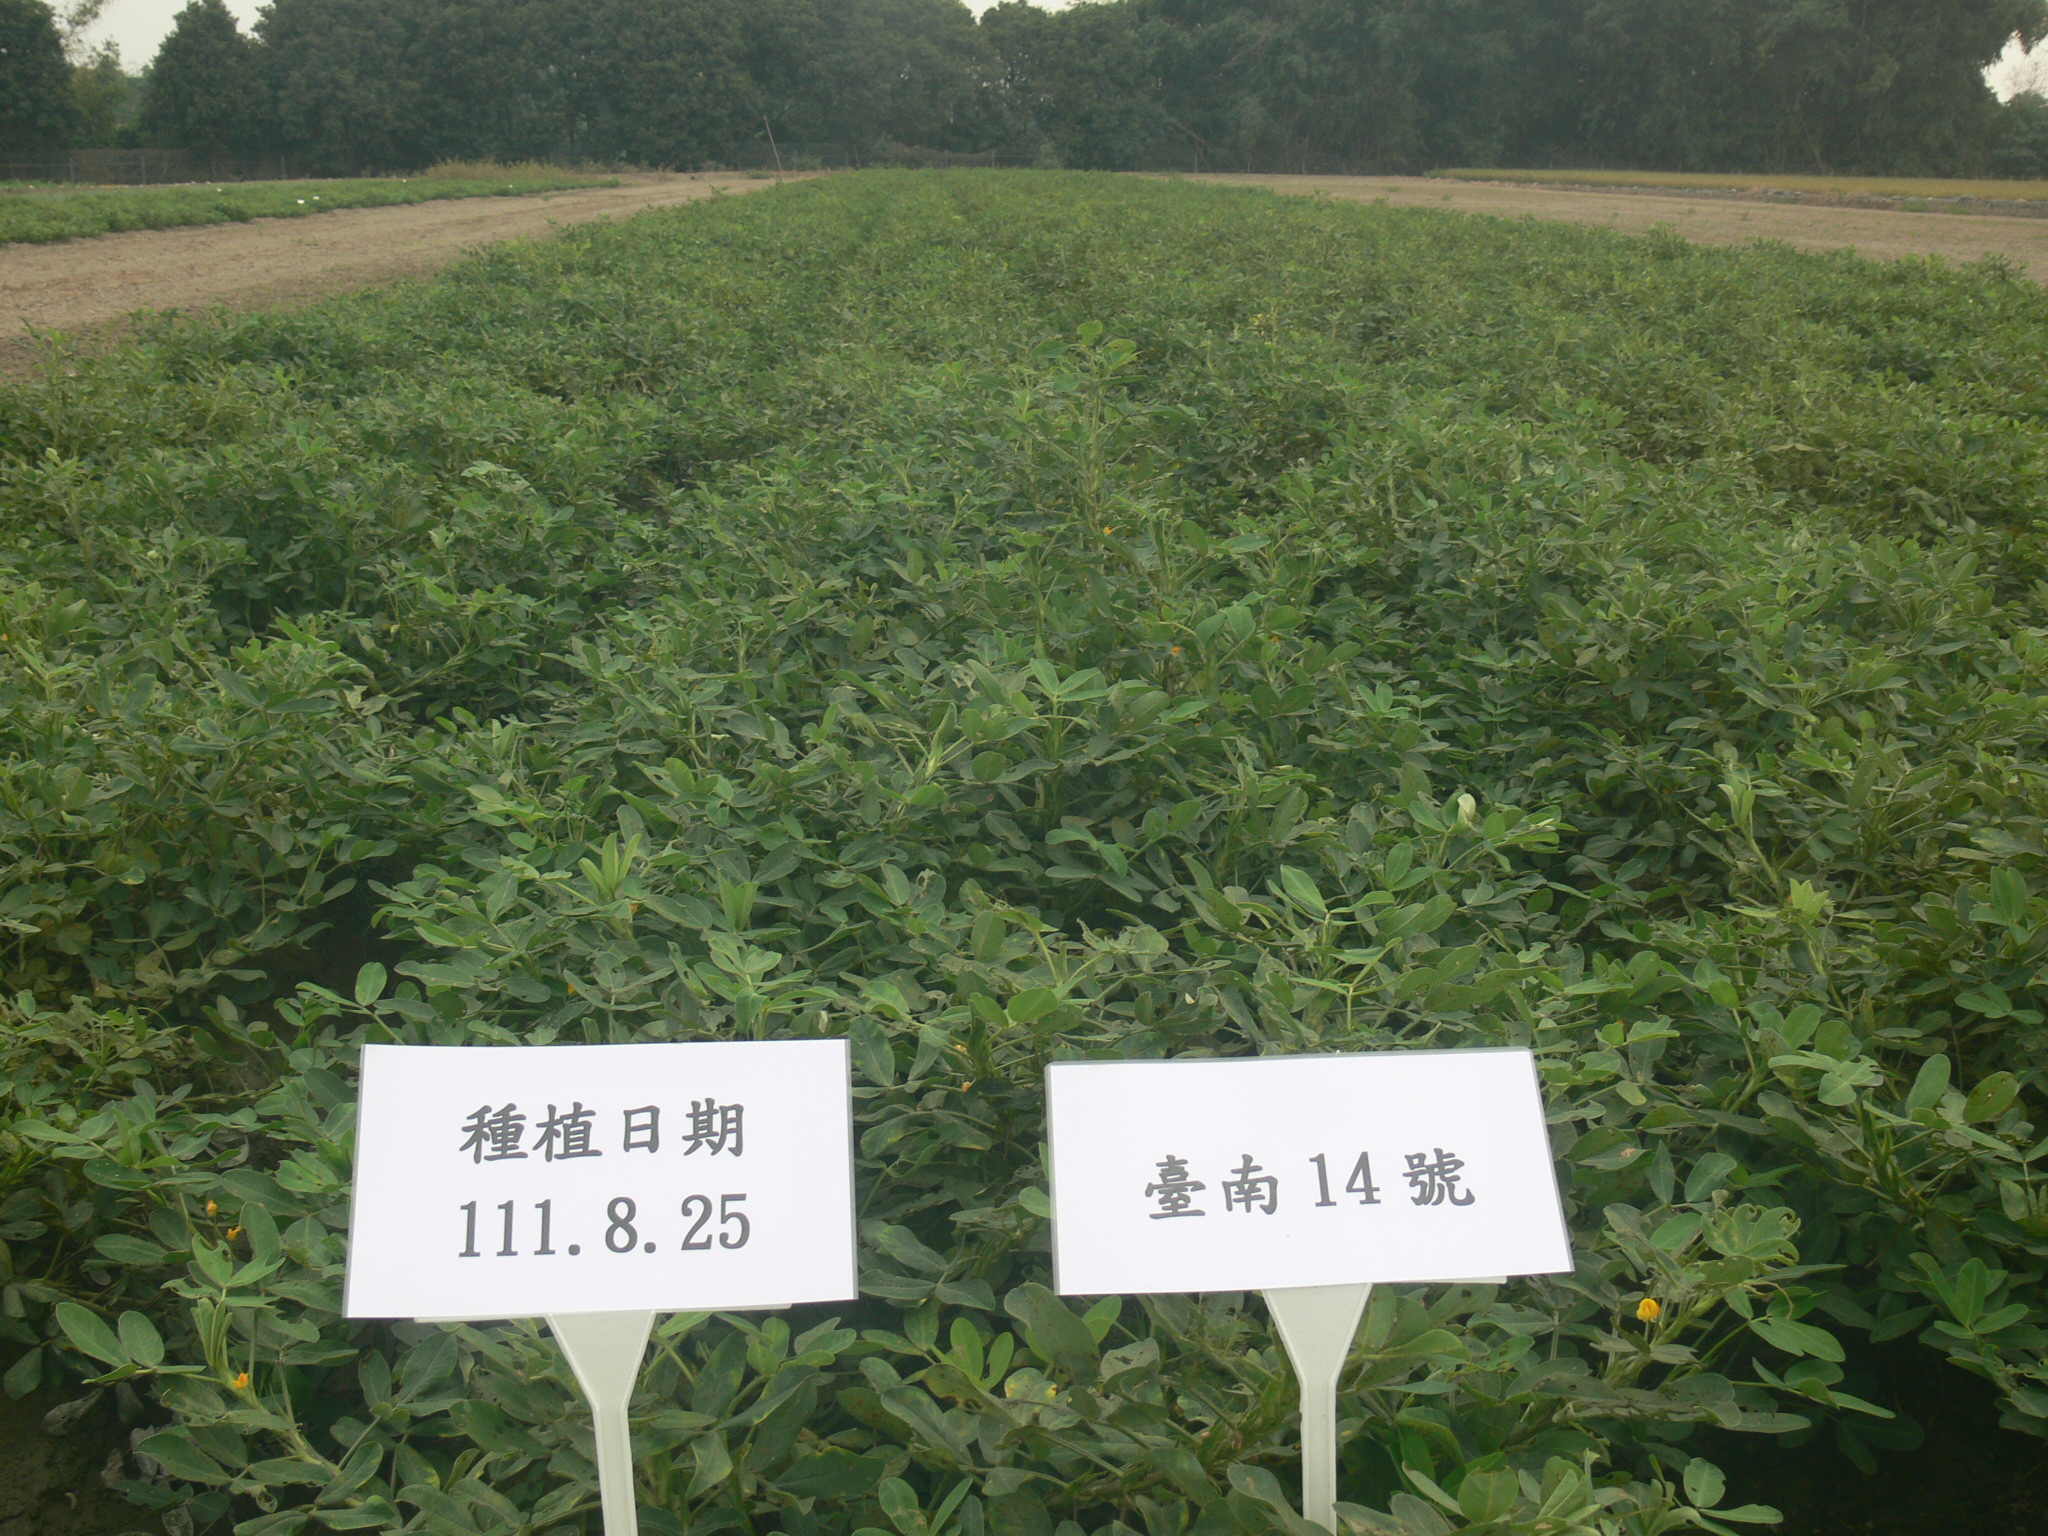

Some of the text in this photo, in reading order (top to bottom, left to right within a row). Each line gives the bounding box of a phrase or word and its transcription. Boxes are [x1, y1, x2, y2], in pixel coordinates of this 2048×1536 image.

[460, 1097, 744, 1164] 種植日期
[459, 1194, 750, 1258] 111.8.25
